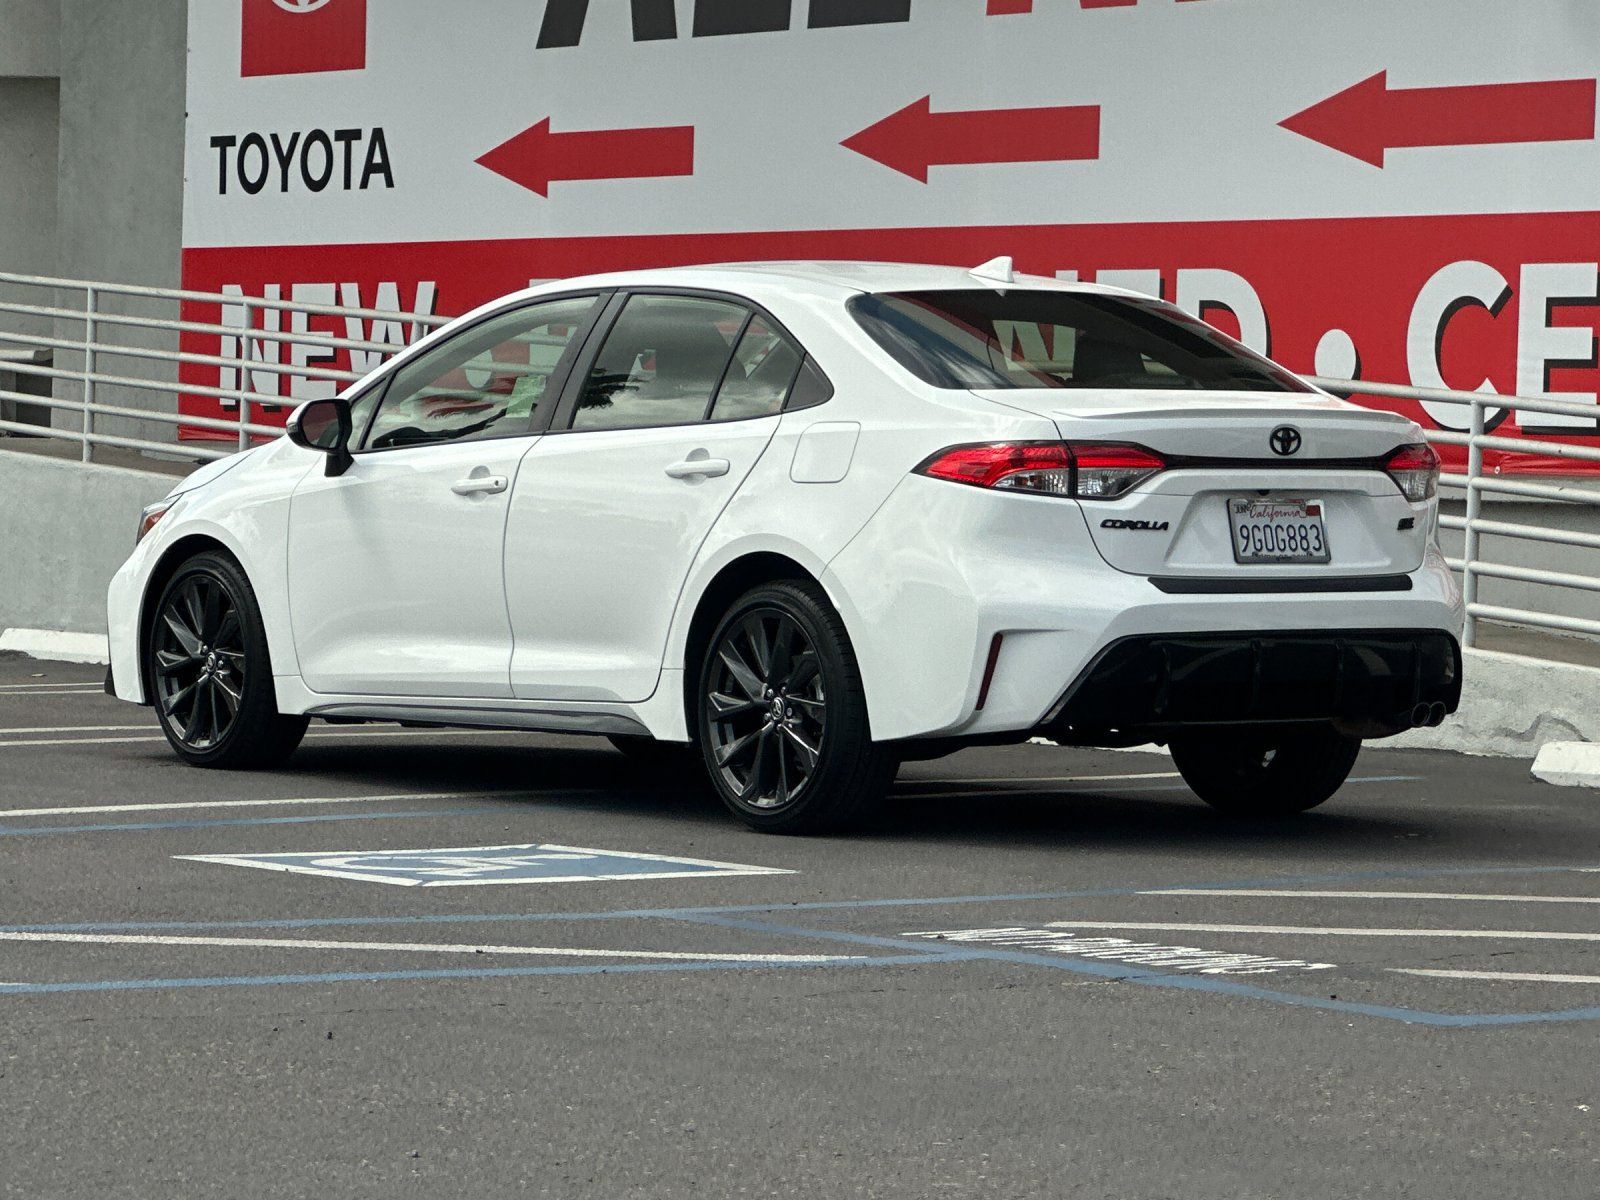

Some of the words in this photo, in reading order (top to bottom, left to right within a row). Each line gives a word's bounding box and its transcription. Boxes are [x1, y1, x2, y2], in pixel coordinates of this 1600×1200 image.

[210, 127, 395, 195] TOYOTA
[219, 281, 438, 408] NEW
[1100, 518, 1170, 531] COROLLA
[1250, 503, 1302, 523] California
